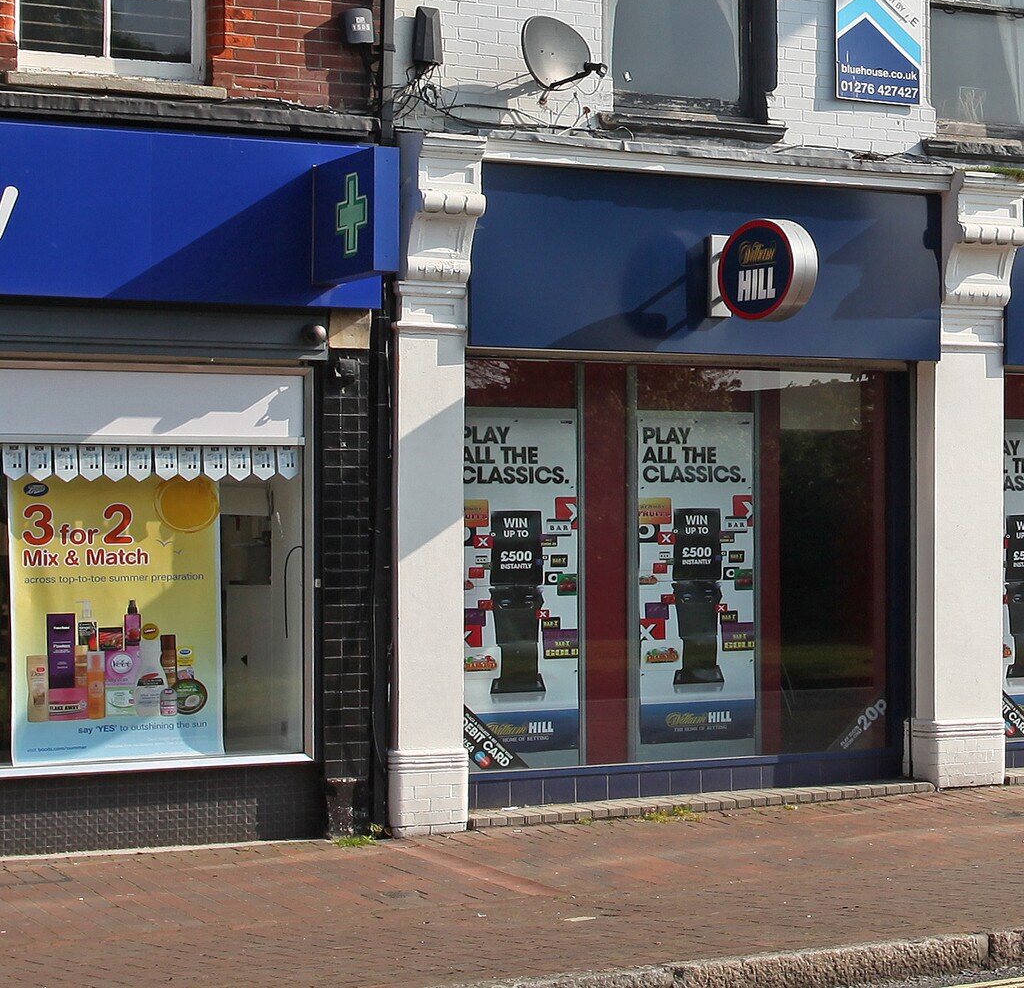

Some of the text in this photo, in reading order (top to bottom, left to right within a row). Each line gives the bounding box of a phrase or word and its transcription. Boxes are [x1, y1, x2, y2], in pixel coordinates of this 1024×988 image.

[896, 1, 905, 12] BY
[841, 63, 918, 81] bluehouse.co.uk
[840, 80, 919, 99] 01276 427427
[738, 240, 777, 267] William
[737, 267, 776, 302] HILL
[643, 427, 691, 445] PLAY
[464, 446, 539, 464] ALL THE
[642, 446, 717, 463] ALL THE
[1003, 440, 1020, 456] AY
[463, 466, 570, 484] CLASSICS.
[643, 466, 746, 483] CLASSICS.
[22, 503, 134, 547] 3 for 2
[503, 517, 528, 528] WIN
[550, 524, 569, 532] BAR
[686, 515, 708, 525] WIN
[503, 530, 529, 538] UP TO
[22, 548, 150, 567] Mix & Match
[500, 550, 532, 562] £500
[682, 546, 712, 558] £500
[24, 572, 204, 584] across top-to-toe summer preparation
[666, 711, 732, 726] William HILL
[78, 726, 93, 735] say
[130, 722, 175, 732] outshining
[176, 721, 190, 729] the
[528, 721, 554, 734] HILL
[464, 717, 486, 744] DEBIT
[483, 740, 510, 767] CARD
